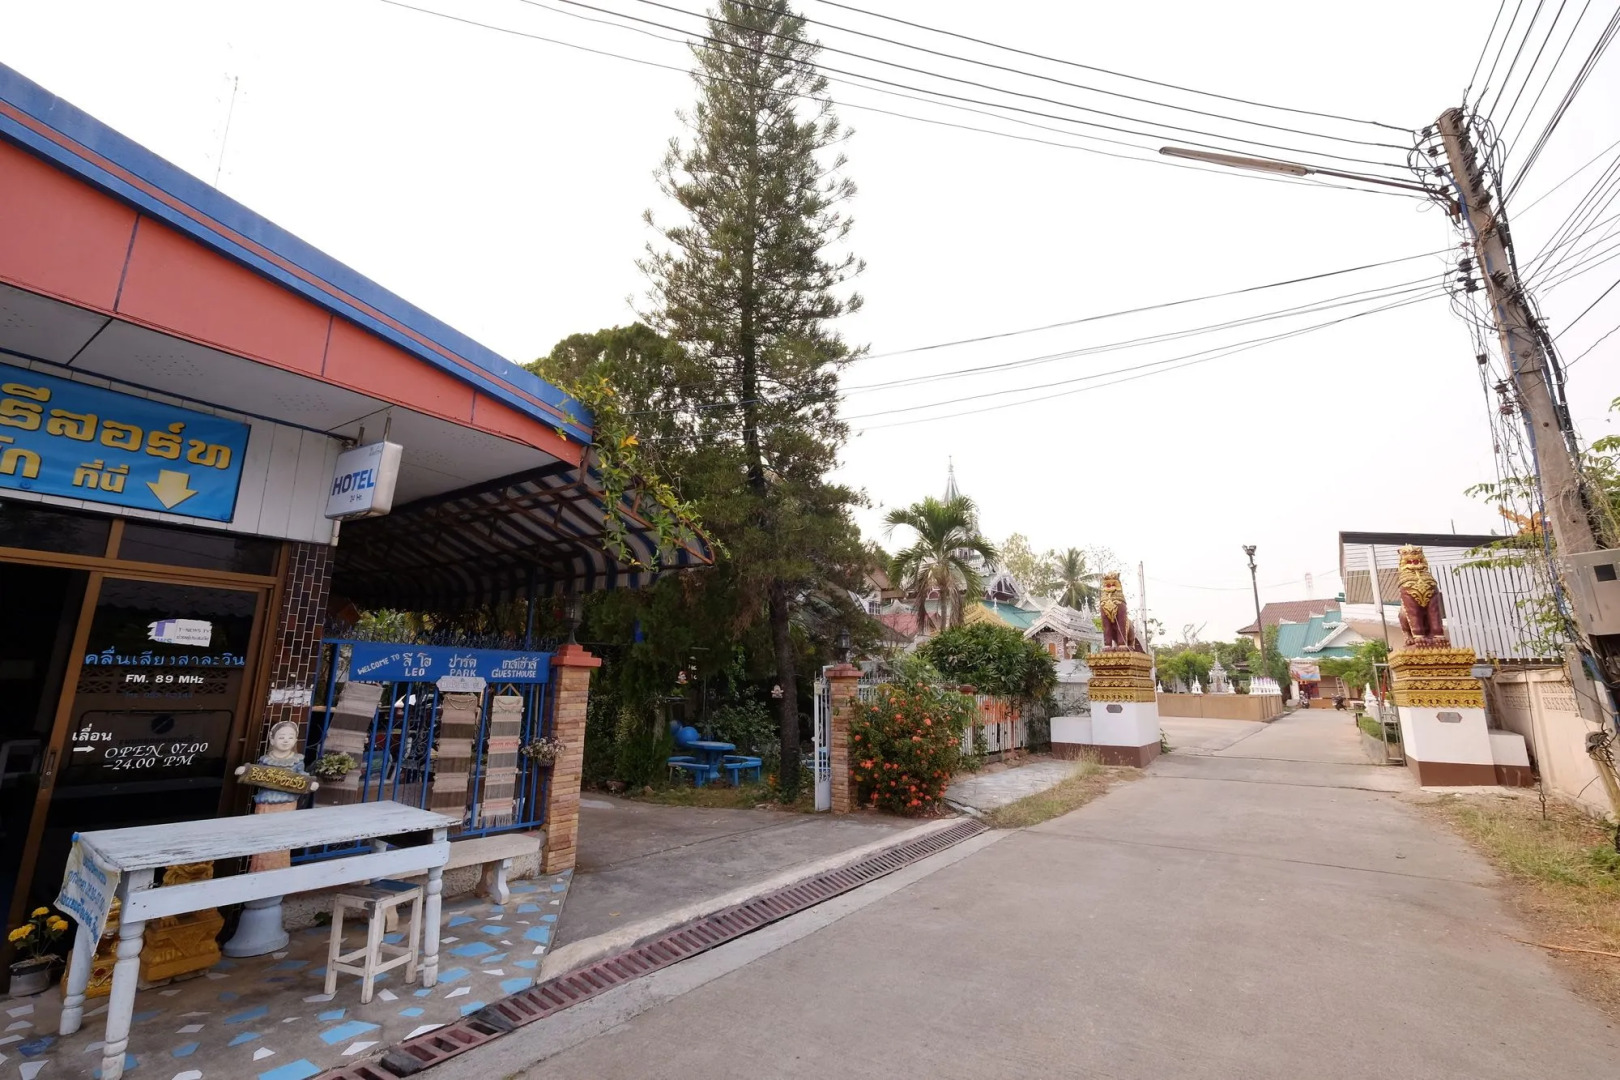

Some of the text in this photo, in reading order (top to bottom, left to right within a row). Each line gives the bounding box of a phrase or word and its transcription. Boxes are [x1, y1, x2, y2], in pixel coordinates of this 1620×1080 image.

[332, 469, 374, 496] HOTEL
[357, 653, 400, 675] WELCOME TO
[404, 667, 537, 678] LEO PARK GUESTHOUSE
[125, 674, 204, 684] FM. 89 MHz
[72, 723, 112, 741] เลื่อน
[104, 742, 208, 759] OPEN 07.00
[163, 753, 196, 768] PM
[250, 766, 306, 790] ยินดีต้อนรับ
